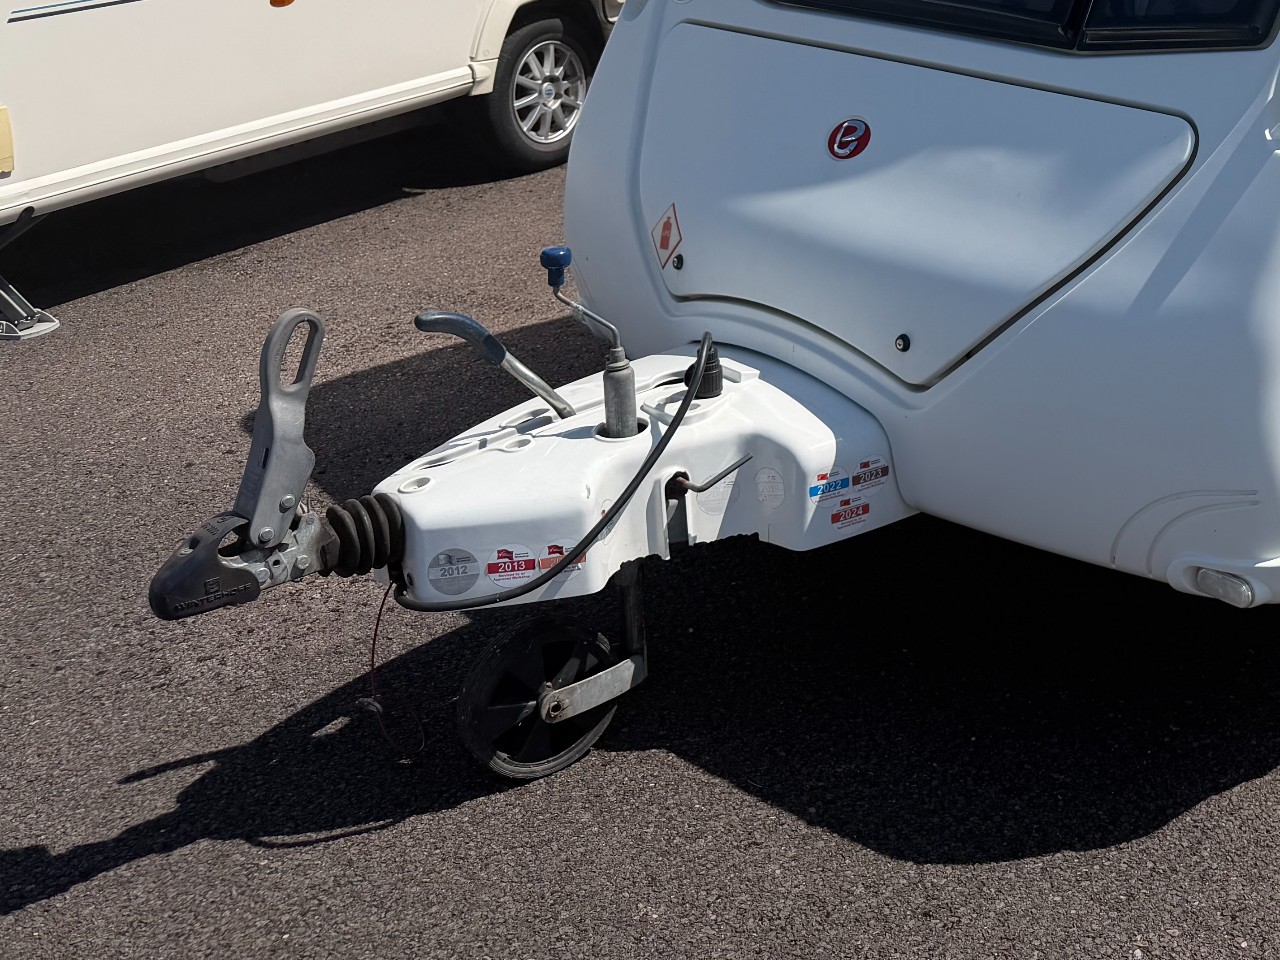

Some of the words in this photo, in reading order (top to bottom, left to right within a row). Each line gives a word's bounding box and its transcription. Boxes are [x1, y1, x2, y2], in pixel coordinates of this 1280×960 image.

[859, 468, 882, 482] 2023
[817, 480, 842, 494] 2022
[839, 506, 863, 521] 2024
[439, 565, 468, 578] 2012
[498, 561, 526, 572] 2013
